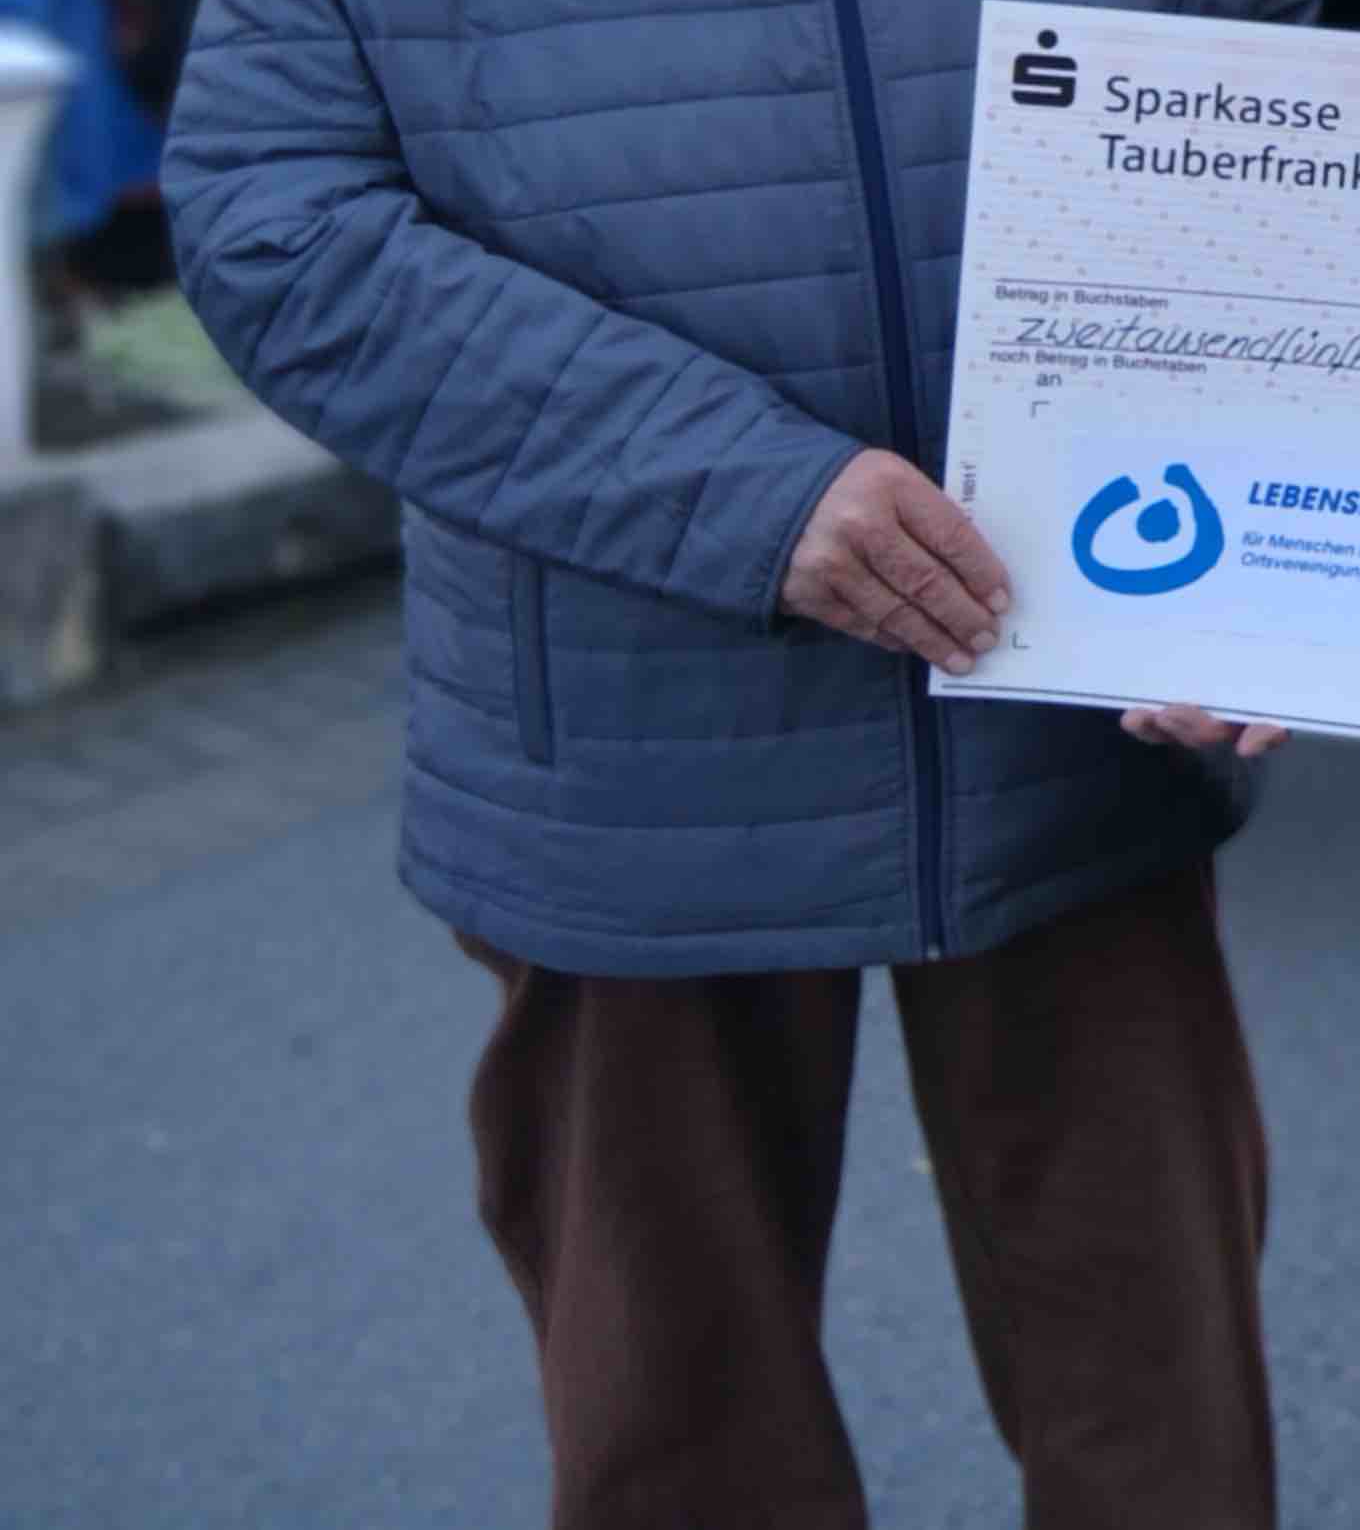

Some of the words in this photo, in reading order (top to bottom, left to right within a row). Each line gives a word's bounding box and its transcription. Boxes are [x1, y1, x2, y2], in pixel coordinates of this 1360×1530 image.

[1105, 75, 1341, 131] Sparkasse
[995, 285, 1048, 304] Betrag
[1054, 289, 1069, 301] in
[1073, 290, 1168, 309] Buchstaben
[990, 350, 1030, 363] noch
[1034, 350, 1088, 369] Betrag
[1093, 354, 1107, 367] in
[1112, 355, 1208, 374] Buchstaben
[1036, 373, 1063, 387] an
[1241, 531, 1264, 546] für
[1268, 533, 1354, 557] Menschen
